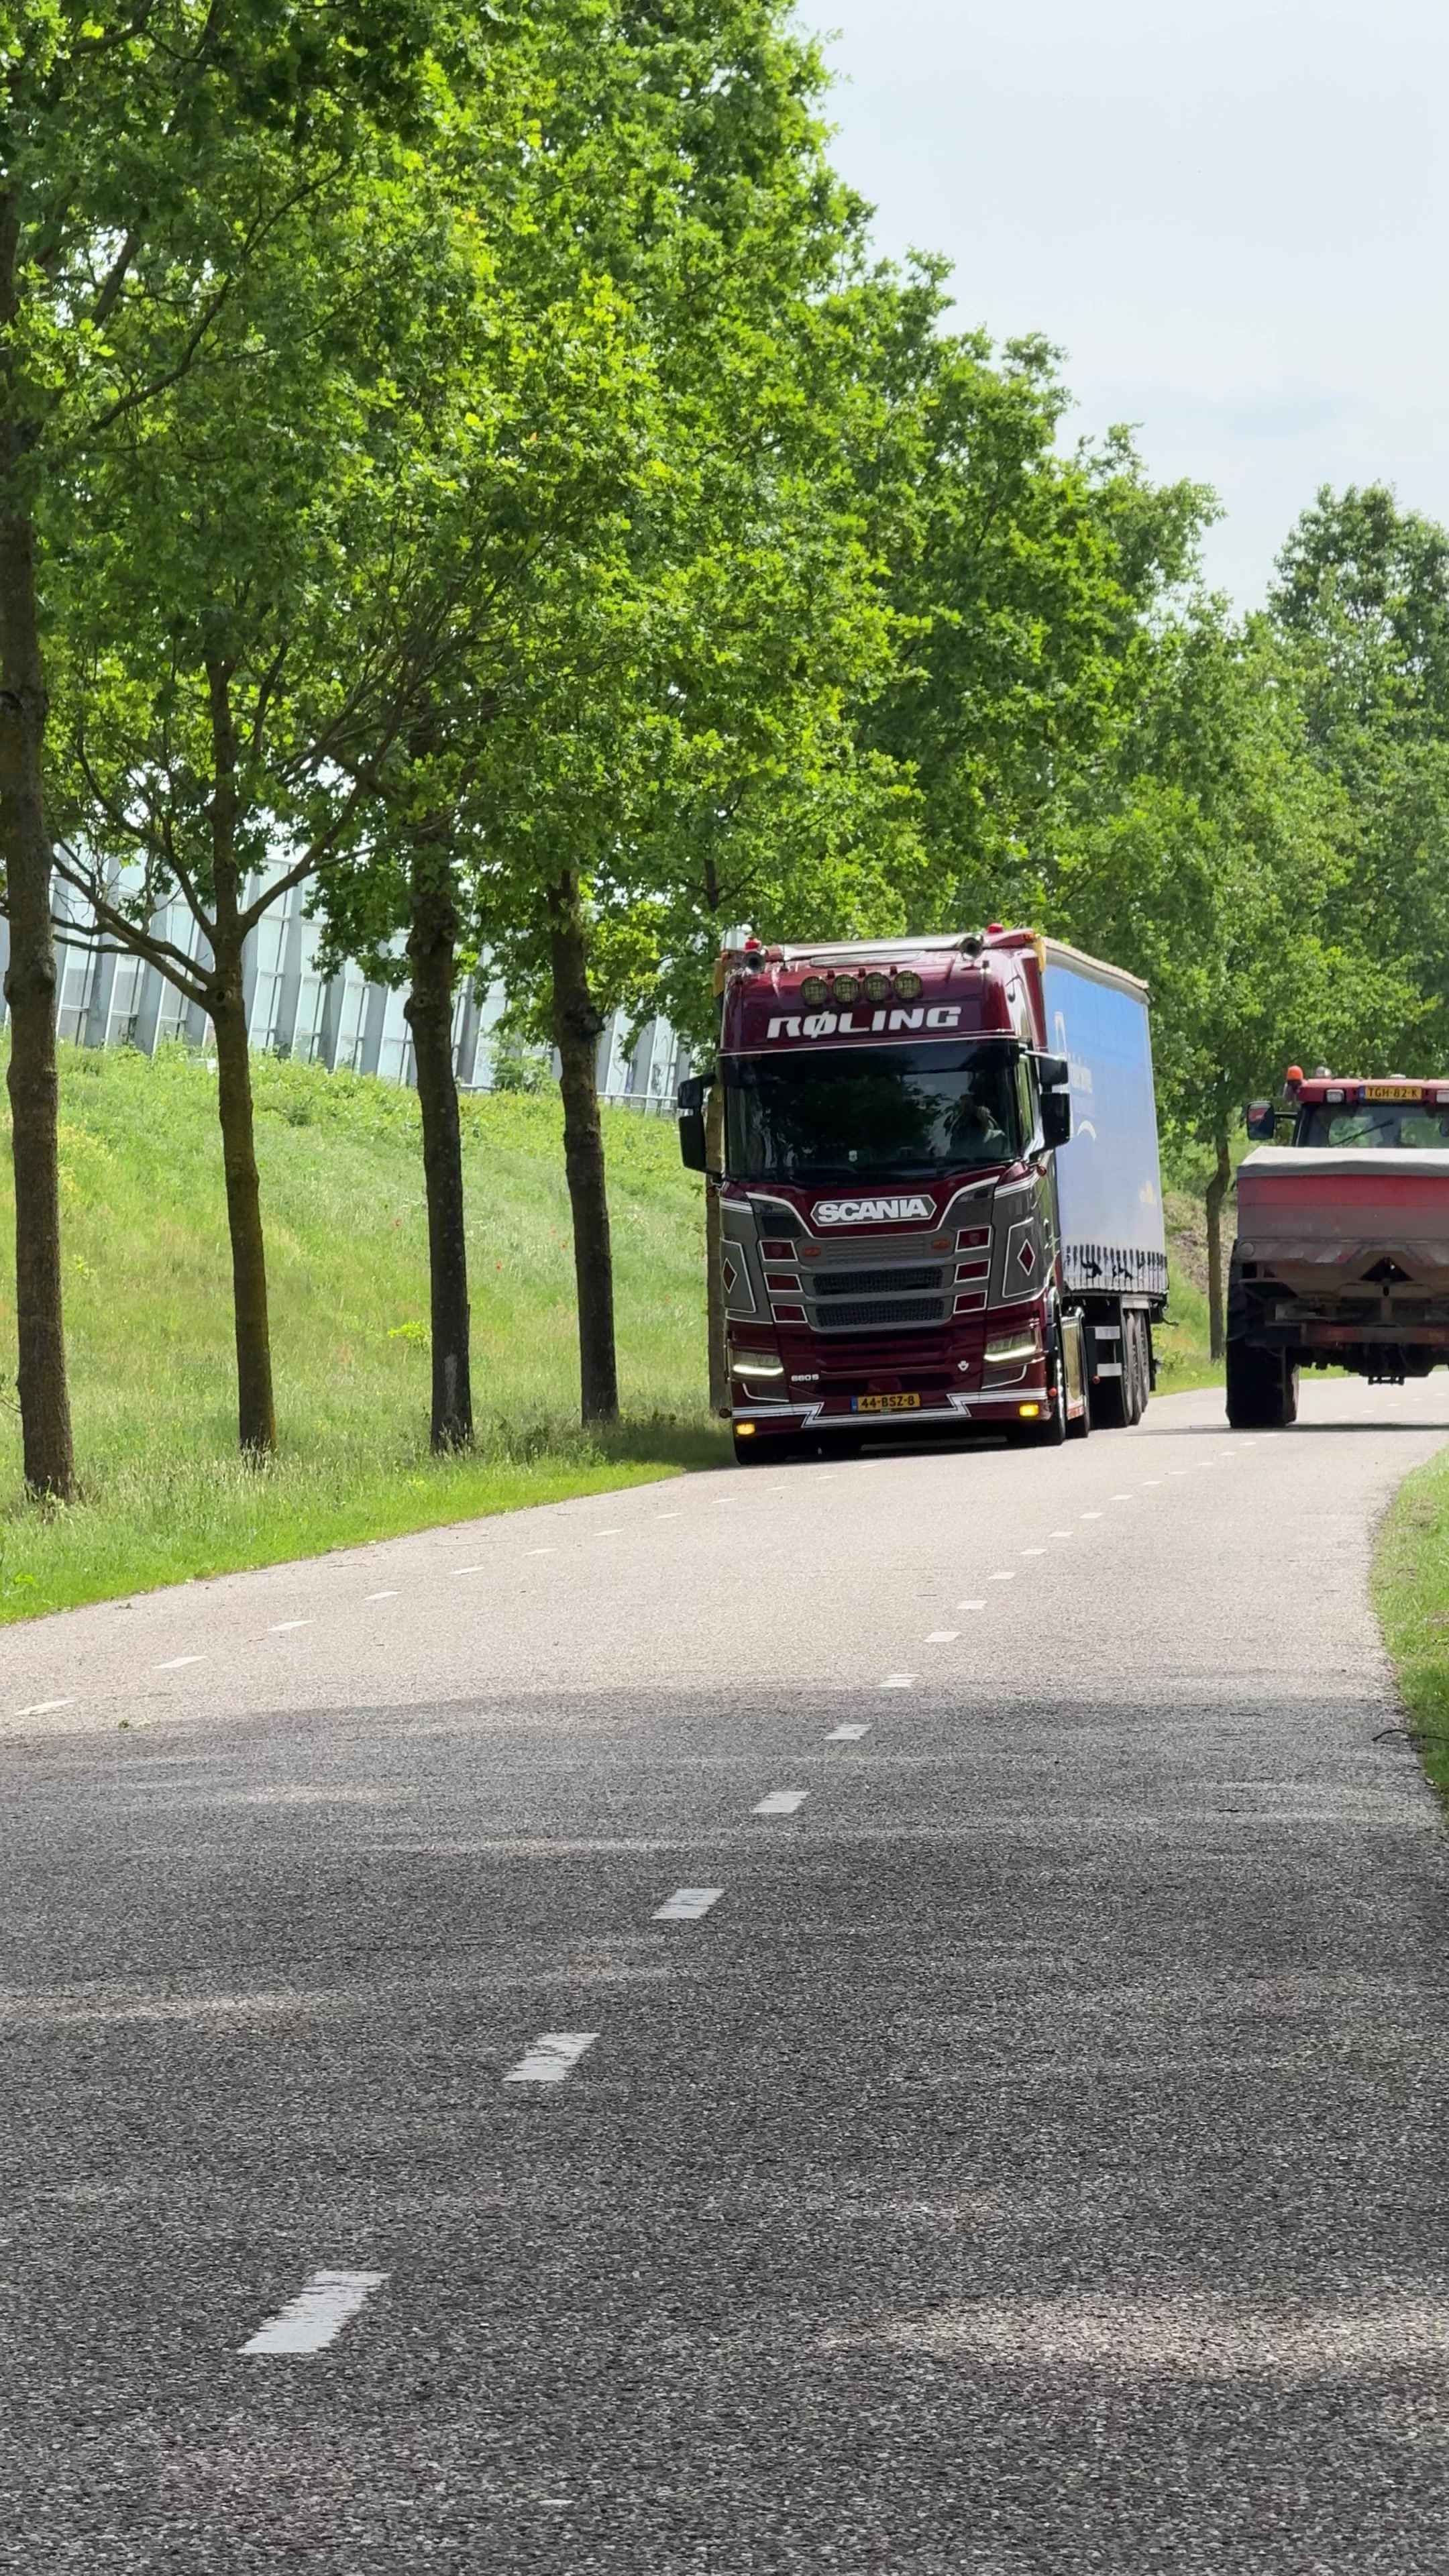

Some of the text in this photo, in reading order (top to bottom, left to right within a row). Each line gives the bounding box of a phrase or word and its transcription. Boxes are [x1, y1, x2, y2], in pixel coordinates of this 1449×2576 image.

[1368, 1087, 1417, 1097] TGH-82-K
[818, 1198, 929, 1222] SCANIA
[861, 1395, 915, 1408] 44-BSZ-8
